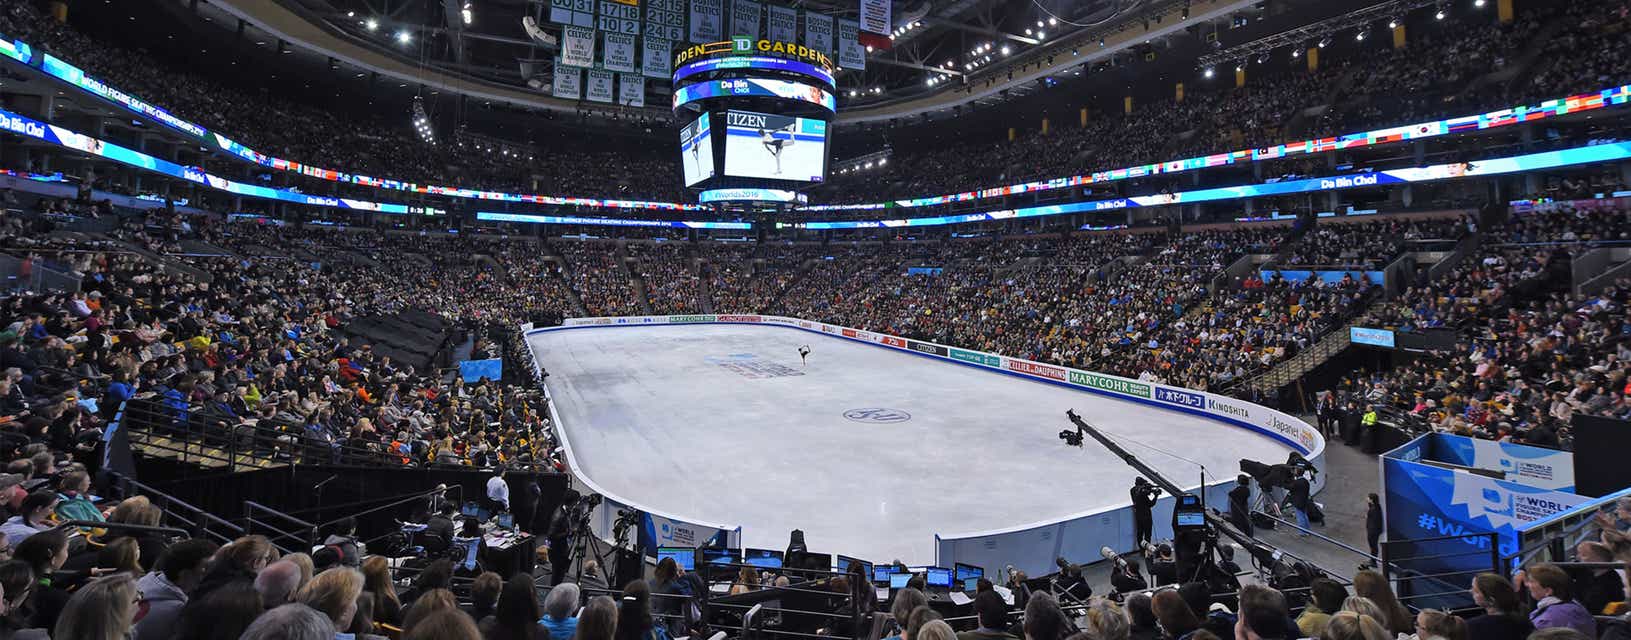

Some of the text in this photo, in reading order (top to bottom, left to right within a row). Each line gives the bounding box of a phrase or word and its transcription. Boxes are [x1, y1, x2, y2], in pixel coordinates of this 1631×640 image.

[602, 4, 638, 19] 17 18
[648, 9, 684, 25] 21 25
[602, 19, 635, 33] 10 2
[808, 17, 831, 27] BOSTON
[567, 30, 592, 40] CELTICS
[647, 22, 665, 34] 24
[670, 28, 679, 39] 6
[808, 25, 830, 36] CELTICS
[607, 35, 632, 44] CELTICS
[733, 38, 751, 51] TD
[757, 39, 825, 65] GARDEN
[556, 67, 579, 76] CELTICS
[721, 80, 748, 89] Da Bin
[82, 77, 107, 93] WORLD
[108, 87, 131, 105] FIGURE
[132, 98, 155, 116] SKATING
[0, 113, 45, 138] Da Bin Choi
[1320, 174, 1377, 189] Da Bin Choi
[916, 343, 937, 353] CITIZEN
[1009, 361, 1030, 373] CELLIER
[1034, 365, 1065, 380] DAUPHINS
[1071, 372, 1129, 393] MARY COHR
